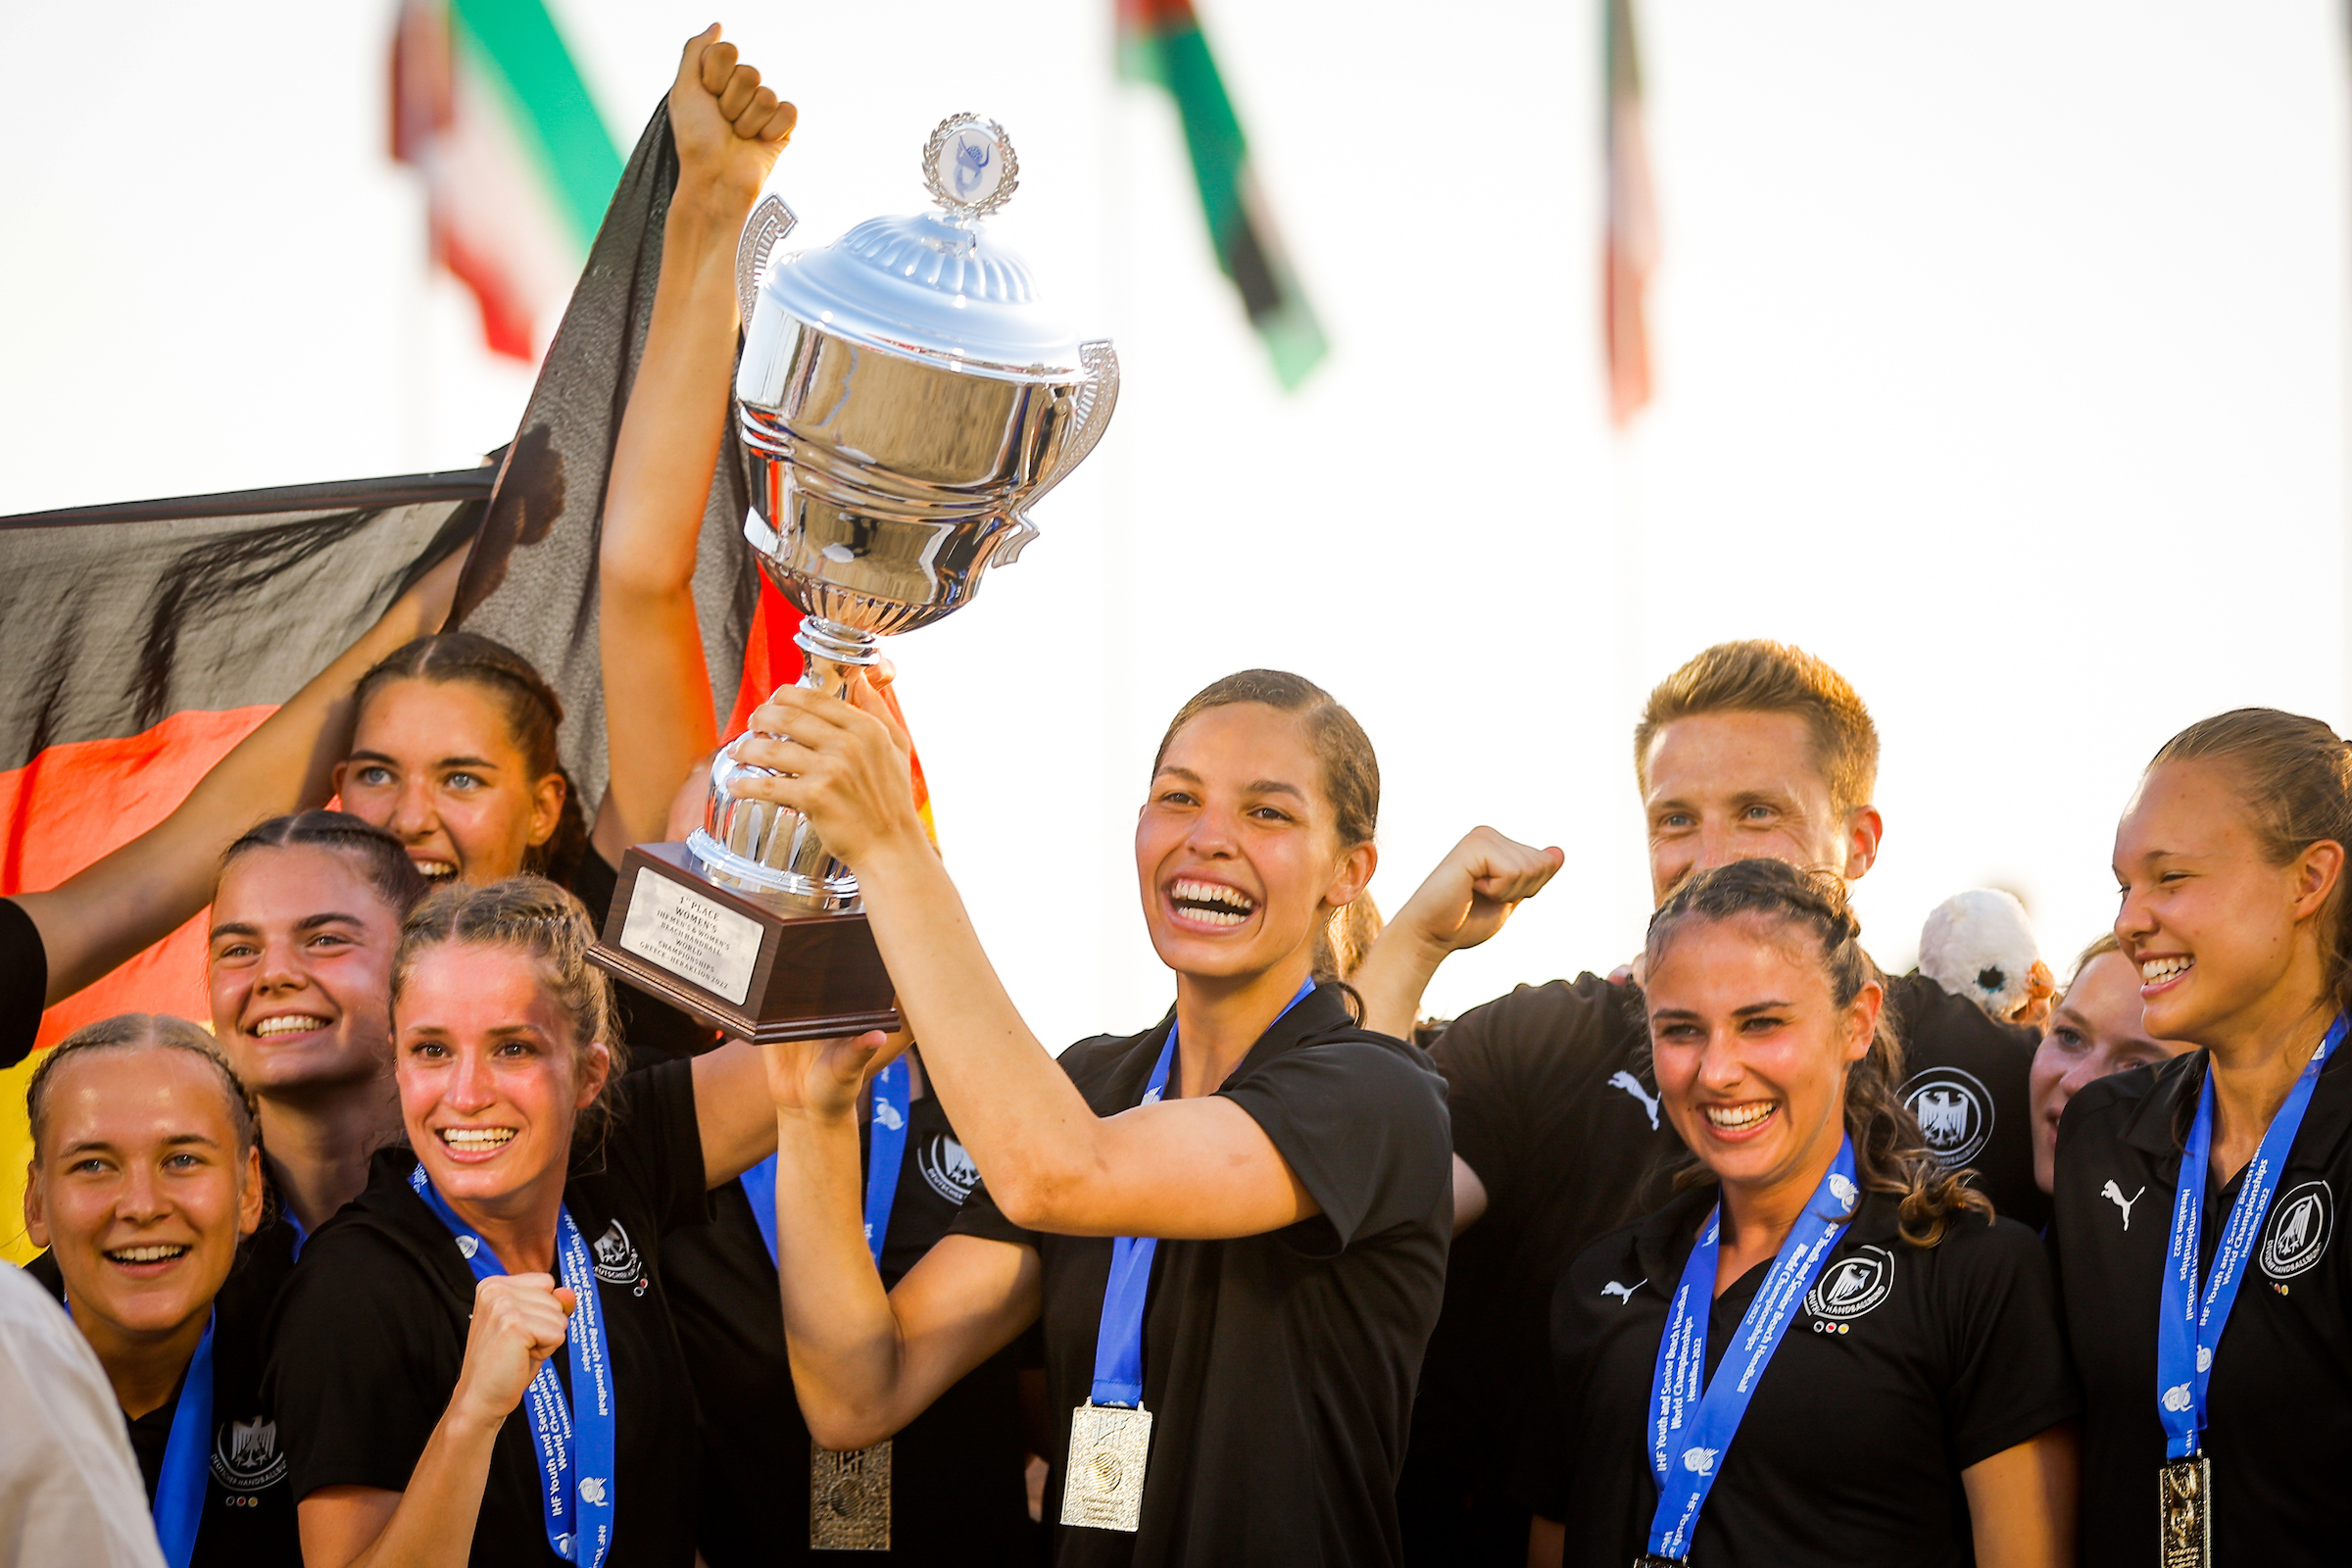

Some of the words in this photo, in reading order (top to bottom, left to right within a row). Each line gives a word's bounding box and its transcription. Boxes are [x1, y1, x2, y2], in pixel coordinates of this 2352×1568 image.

[675, 906, 717, 933] WOMEN'S
[691, 902, 719, 921] PLACE
[661, 921, 684, 937] BEACH
[684, 933, 721, 956] HANDBALL
[676, 939, 703, 956] WORLD
[698, 929, 730, 951] WOMEN'S
[640, 941, 665, 958] GREECE
[670, 956, 710, 980] HERAKLION
[710, 977, 728, 989] 2022
[658, 940, 714, 973] CHAMPIONSHIPS
[2177, 1188, 2191, 1234] Heraklion
[2222, 1250, 2239, 1286] World
[2234, 1158, 2269, 1249] Championships
[2240, 1212, 2262, 1258] Heraklion
[2257, 1187, 2271, 1212] 2022
[570, 1233, 587, 1265] Youth
[1806, 1237, 1832, 1264] Youth
[2173, 1234, 2184, 1258] 2022
[2180, 1197, 2197, 1282] ampionships
[2199, 1306, 2211, 1327] IHF
[2206, 1271, 2225, 1305] Youth
[2220, 1246, 2232, 1270] and
[2227, 1206, 2243, 1246] Senior
[2237, 1169, 2254, 1205] Beach
[1784, 1243, 1809, 1273] World
[1795, 1261, 1812, 1282] and
[579, 1265, 592, 1289] and
[2185, 1266, 2198, 1321] Handball
[565, 1250, 580, 1284] World
[573, 1285, 592, 1372] Championships
[583, 1289, 596, 1327] Senior
[1672, 1284, 1690, 1330] Handball
[1744, 1270, 1791, 1352] Championships
[1778, 1278, 1802, 1311] Senior
[1745, 1302, 1762, 1325] 2022
[1761, 1311, 1785, 1344] Beach
[570, 1319, 579, 1344] 2022
[588, 1328, 602, 1362] Beach
[1665, 1329, 1681, 1360] Beach
[1673, 1315, 1694, 1396] Championships
[1691, 1337, 1702, 1360] 2022
[545, 1368, 560, 1392] 2022
[1661, 1360, 1674, 1395] Senior
[1687, 1359, 1700, 1402] Heraklion
[1737, 1344, 1768, 1394] Handball
[536, 1368, 561, 1433] Champion
[594, 1363, 608, 1417] Handball
[1659, 1396, 1671, 1416] and
[532, 1394, 550, 1433] Senior
[555, 1393, 572, 1440] Heraklion
[1670, 1396, 1684, 1430] World
[540, 1433, 554, 1457] and
[1656, 1416, 1669, 1450] Youth
[553, 1434, 567, 1471] World
[1656, 1450, 1667, 1471] IHF
[546, 1457, 560, 1495] Youth
[551, 1494, 564, 1517] IHF
[1687, 1493, 1700, 1513] IHF
[597, 1524, 608, 1546] IHF
[1672, 1513, 1692, 1546] Youth
